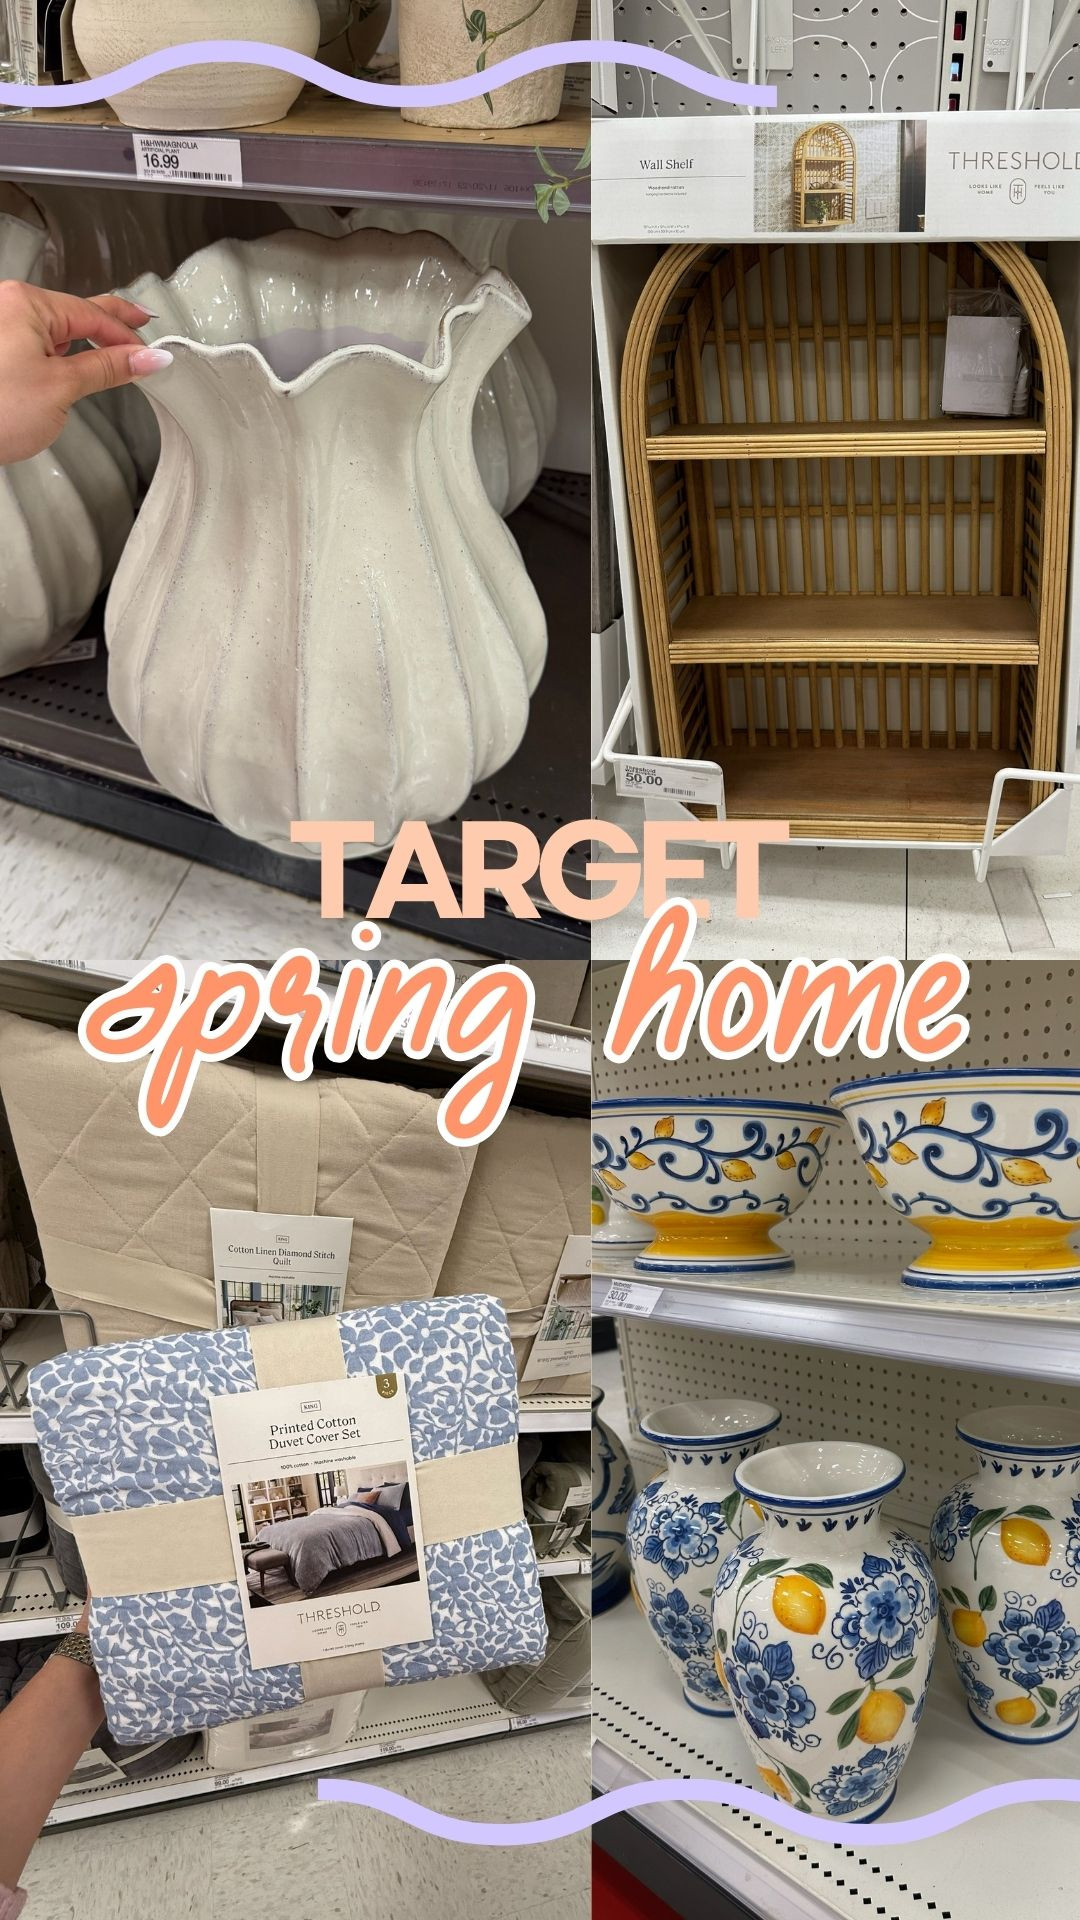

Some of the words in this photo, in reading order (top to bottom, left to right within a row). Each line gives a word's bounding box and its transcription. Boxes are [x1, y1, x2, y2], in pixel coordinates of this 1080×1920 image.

[140, 139, 199, 150] H&HWMAGNOLIA
[143, 153, 180, 169] 16.99
[639, 159, 664, 170] Wall
[665, 158, 694, 170] Shelf
[625, 772, 663, 786] 50.00
[228, 1244, 254, 1254] Cotton
[255, 1246, 277, 1257] Linen
[278, 1248, 312, 1259] Diamond
[313, 1250, 336, 1260] Stitch
[272, 1257, 292, 1266] Quilt
[607, 1290, 628, 1302] 30.00
[383, 1378, 391, 1389] 3
[303, 1402, 319, 1411] KING
[270, 1420, 315, 1436] Printed
[316, 1416, 357, 1431] Cotton
[268, 1435, 305, 1451] Duvet
[306, 1431, 340, 1446] Cover
[342, 1428, 361, 1440] Set
[293, 1461, 310, 1469] cotton
[297, 1600, 381, 1624] THRESHOLD
[56, 1621, 78, 1630] 109.0
